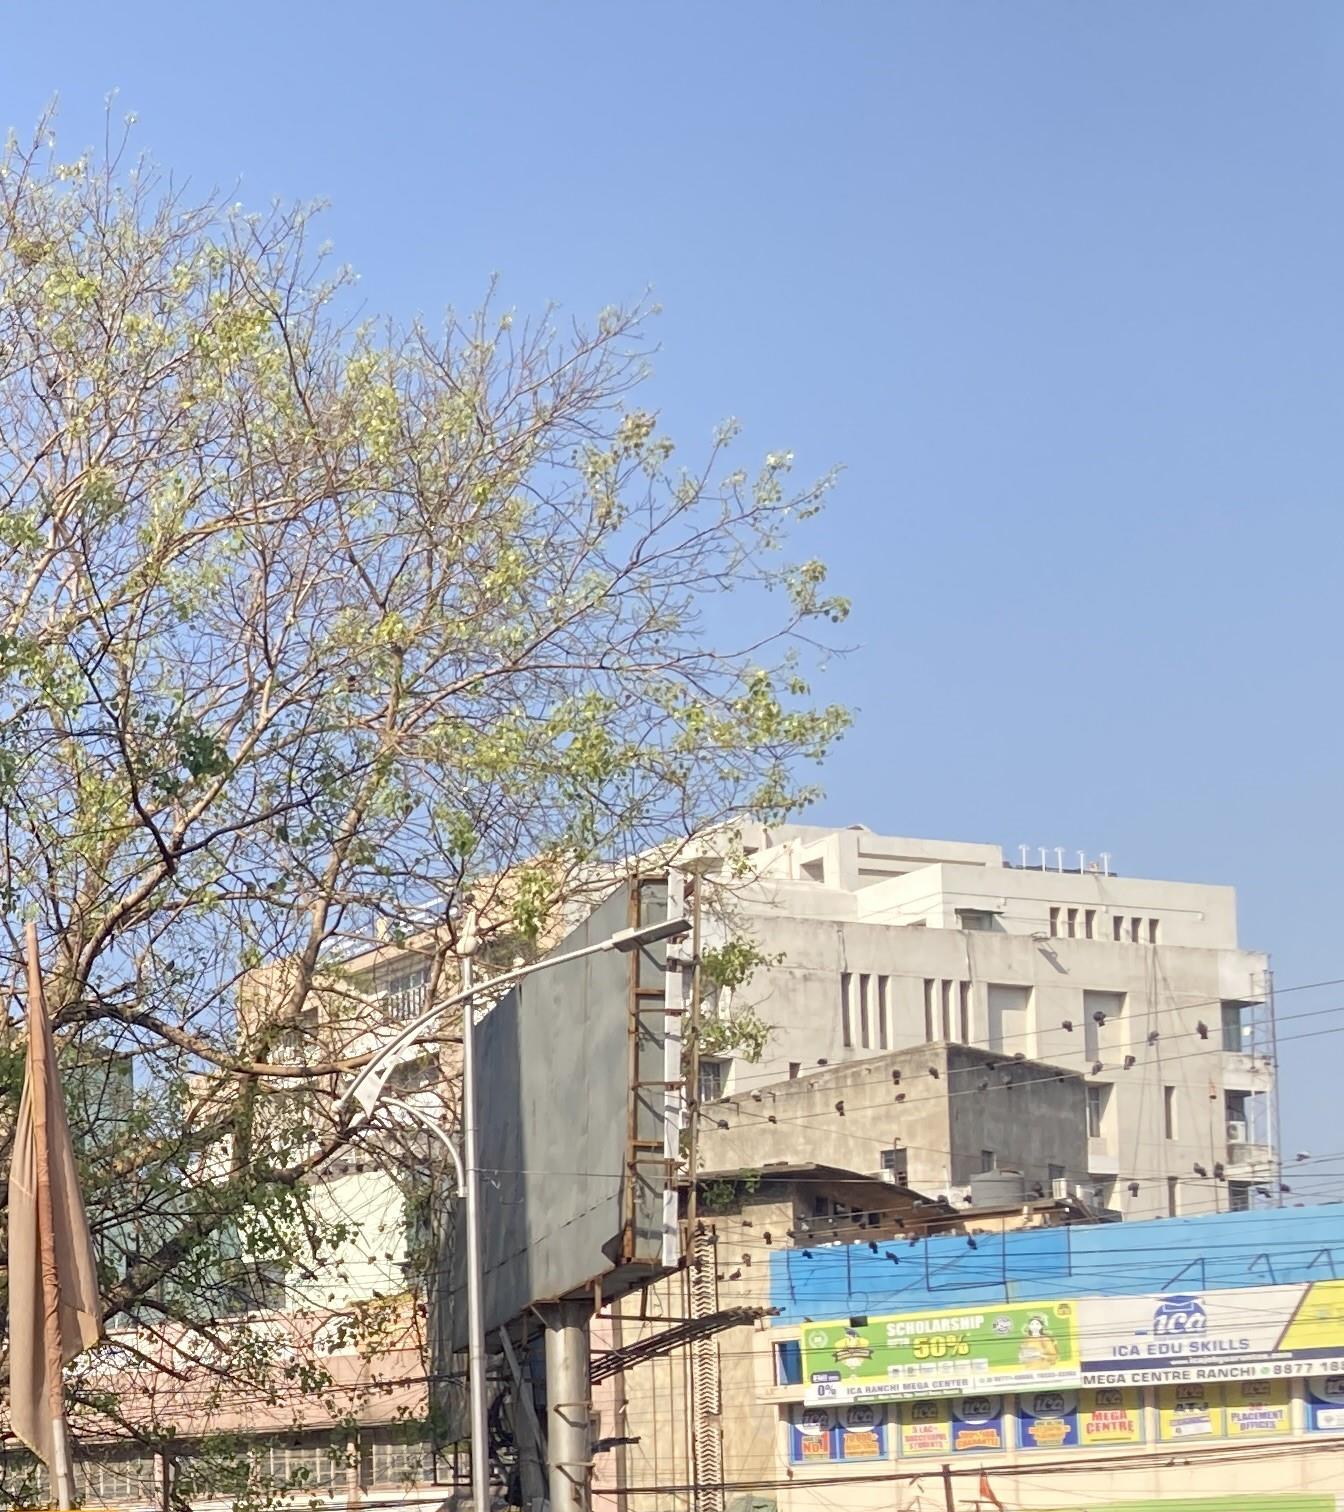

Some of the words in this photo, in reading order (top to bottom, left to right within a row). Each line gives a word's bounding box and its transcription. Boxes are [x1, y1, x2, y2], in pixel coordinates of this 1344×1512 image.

[886, 1315, 985, 1337] SCHOLARSHIP
[912, 1334, 971, 1360] 50%
[1112, 1345, 1141, 1358] ICA
[1147, 1343, 1183, 1356] EDU
[1188, 1338, 1250, 1354] SKILLS
[1083, 1372, 1126, 1386] MEGA
[1131, 1368, 1191, 1384] CENTRE
[1196, 1365, 1256, 1379] RANCHI
[817, 1384, 837, 1397] 0%
[846, 1386, 864, 1396] ICA
[865, 1383, 900, 1395] RANCHI
[902, 1380, 930, 1391] MEGA
[931, 1378, 969, 1390] CENTER
[1092, 1410, 1127, 1421] MEGA
[1231, 1410, 1283, 1422] PLACEMENT
[1086, 1421, 1135, 1434] CENTRE
[1240, 1421, 1276, 1431] OFFICES
